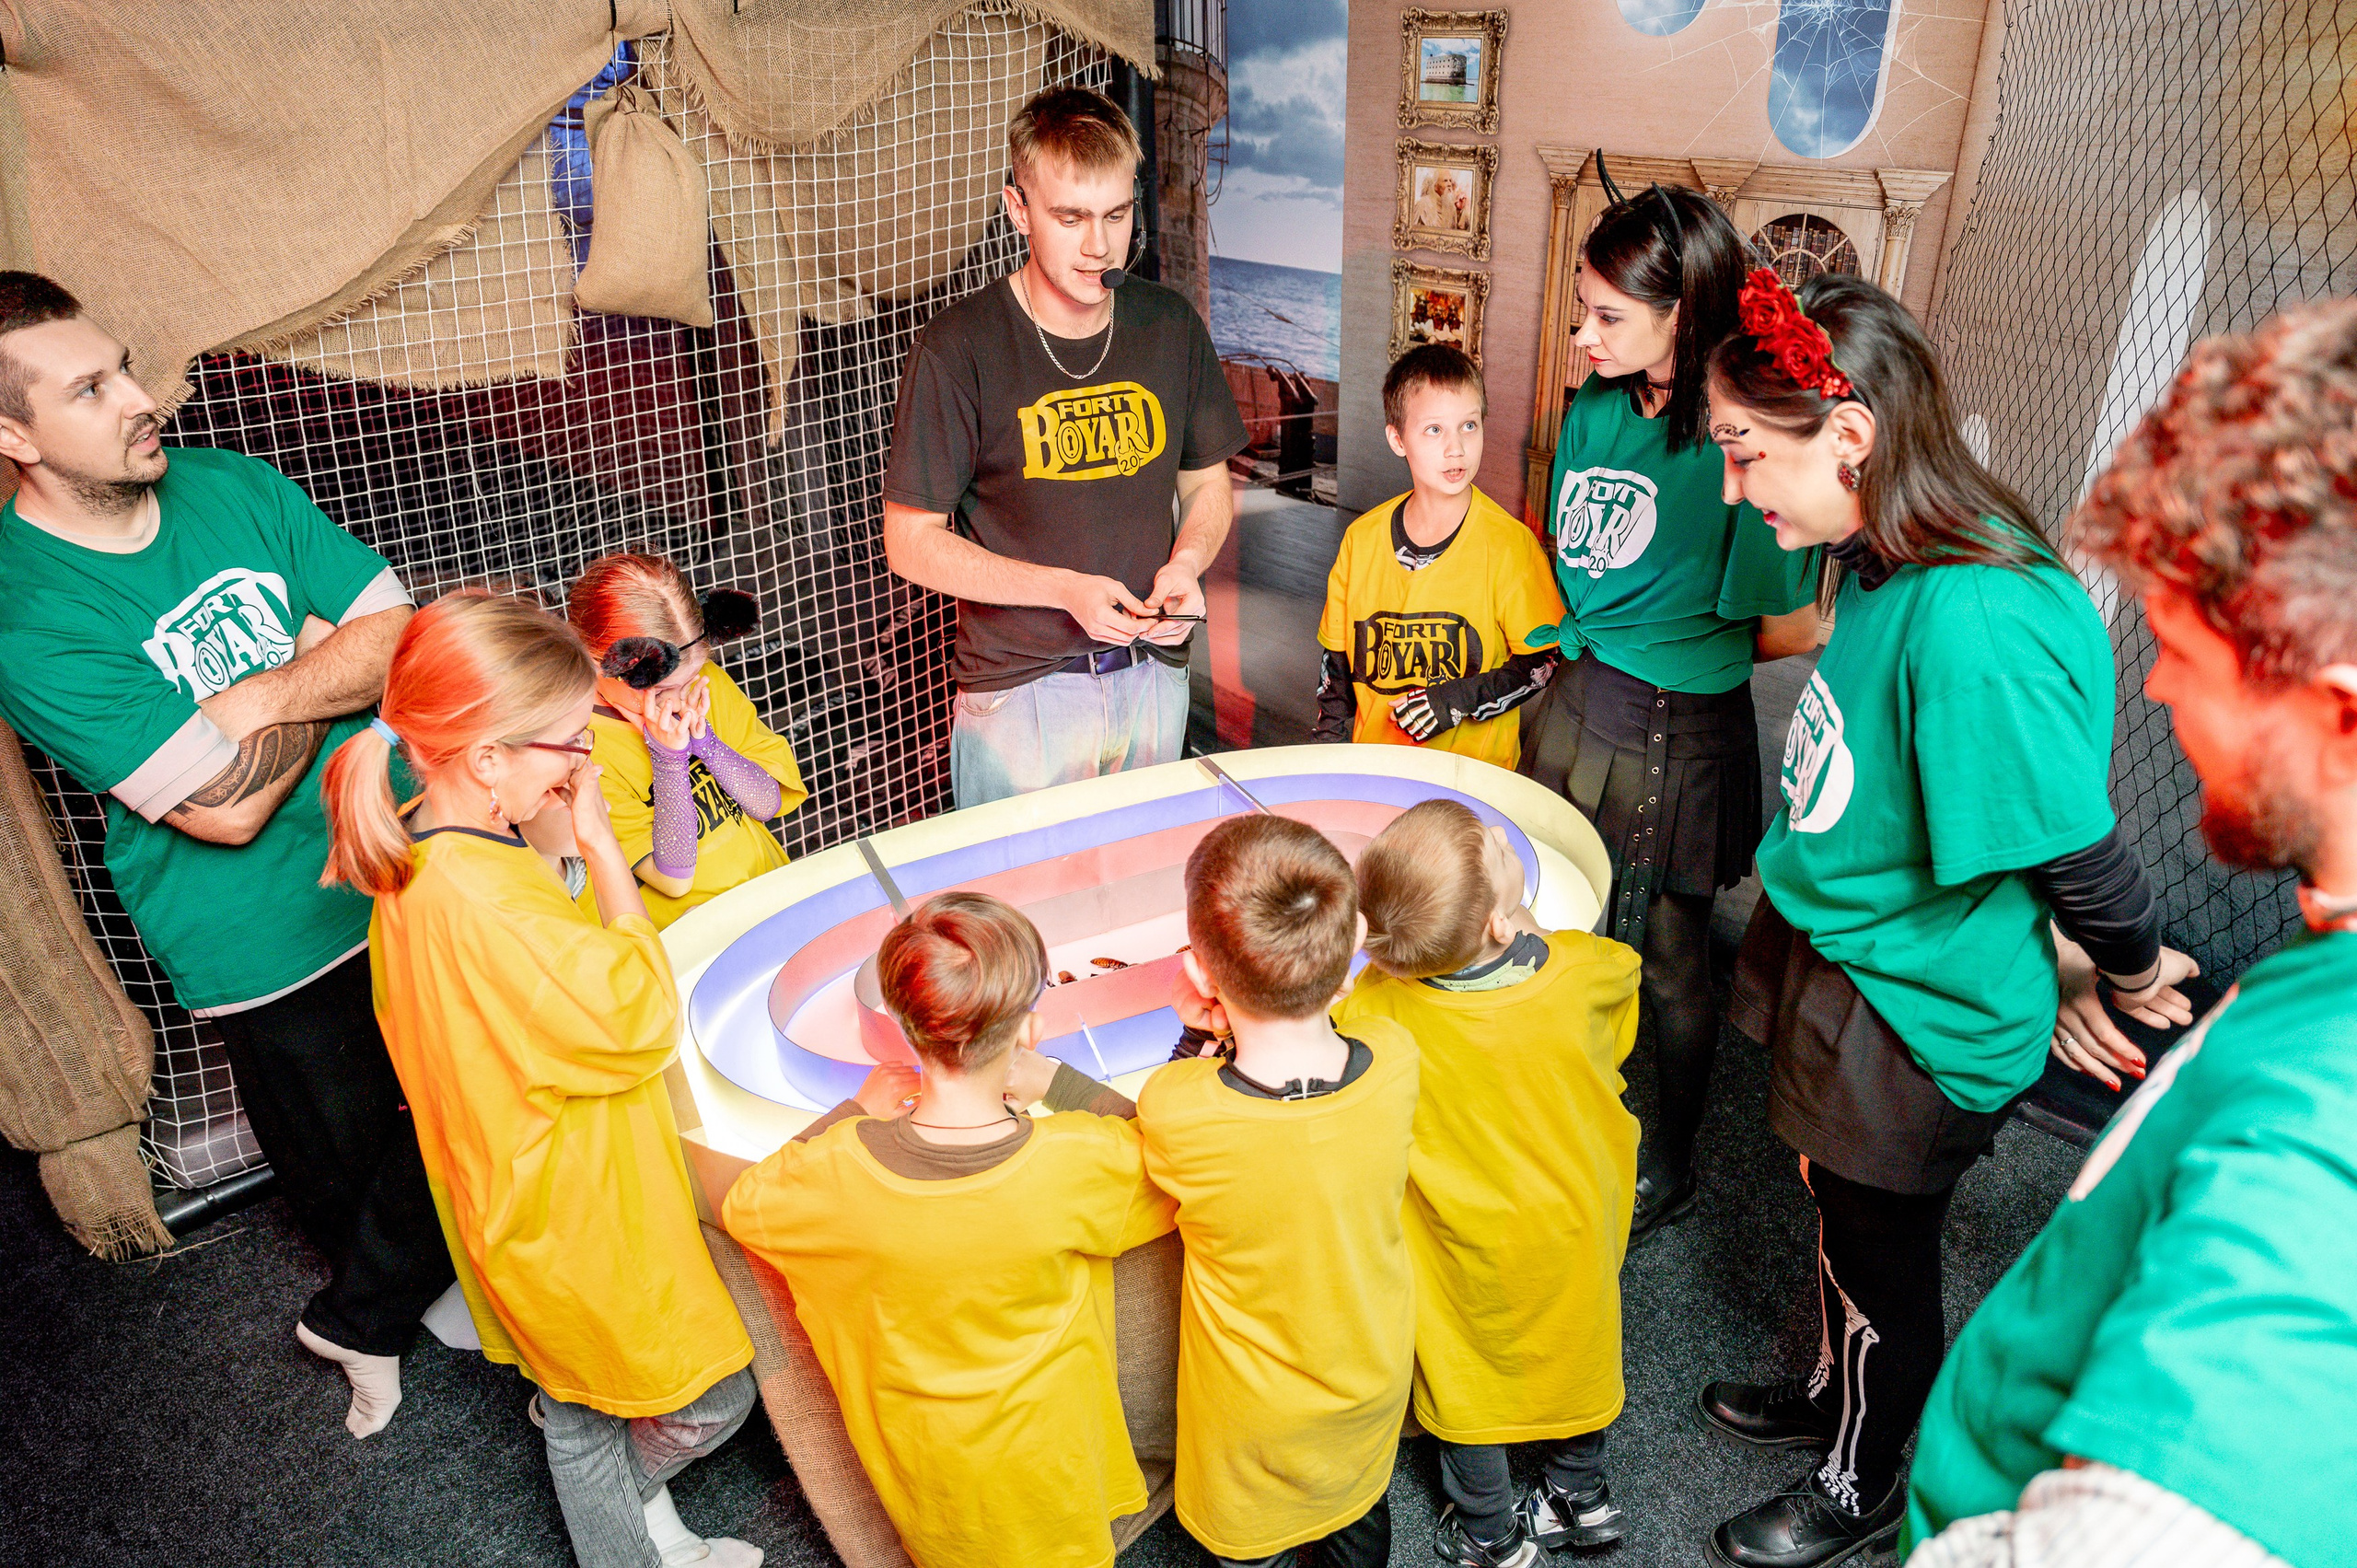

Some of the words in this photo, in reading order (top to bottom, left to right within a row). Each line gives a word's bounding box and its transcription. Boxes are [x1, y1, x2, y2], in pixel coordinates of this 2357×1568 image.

[1058, 394, 1125, 420] FORT
[1017, 381, 1167, 481] BOYARD
[1120, 455, 1139, 472] 2.0
[1384, 621, 1442, 639] FORT
[1353, 610, 1483, 695] BOYARD
